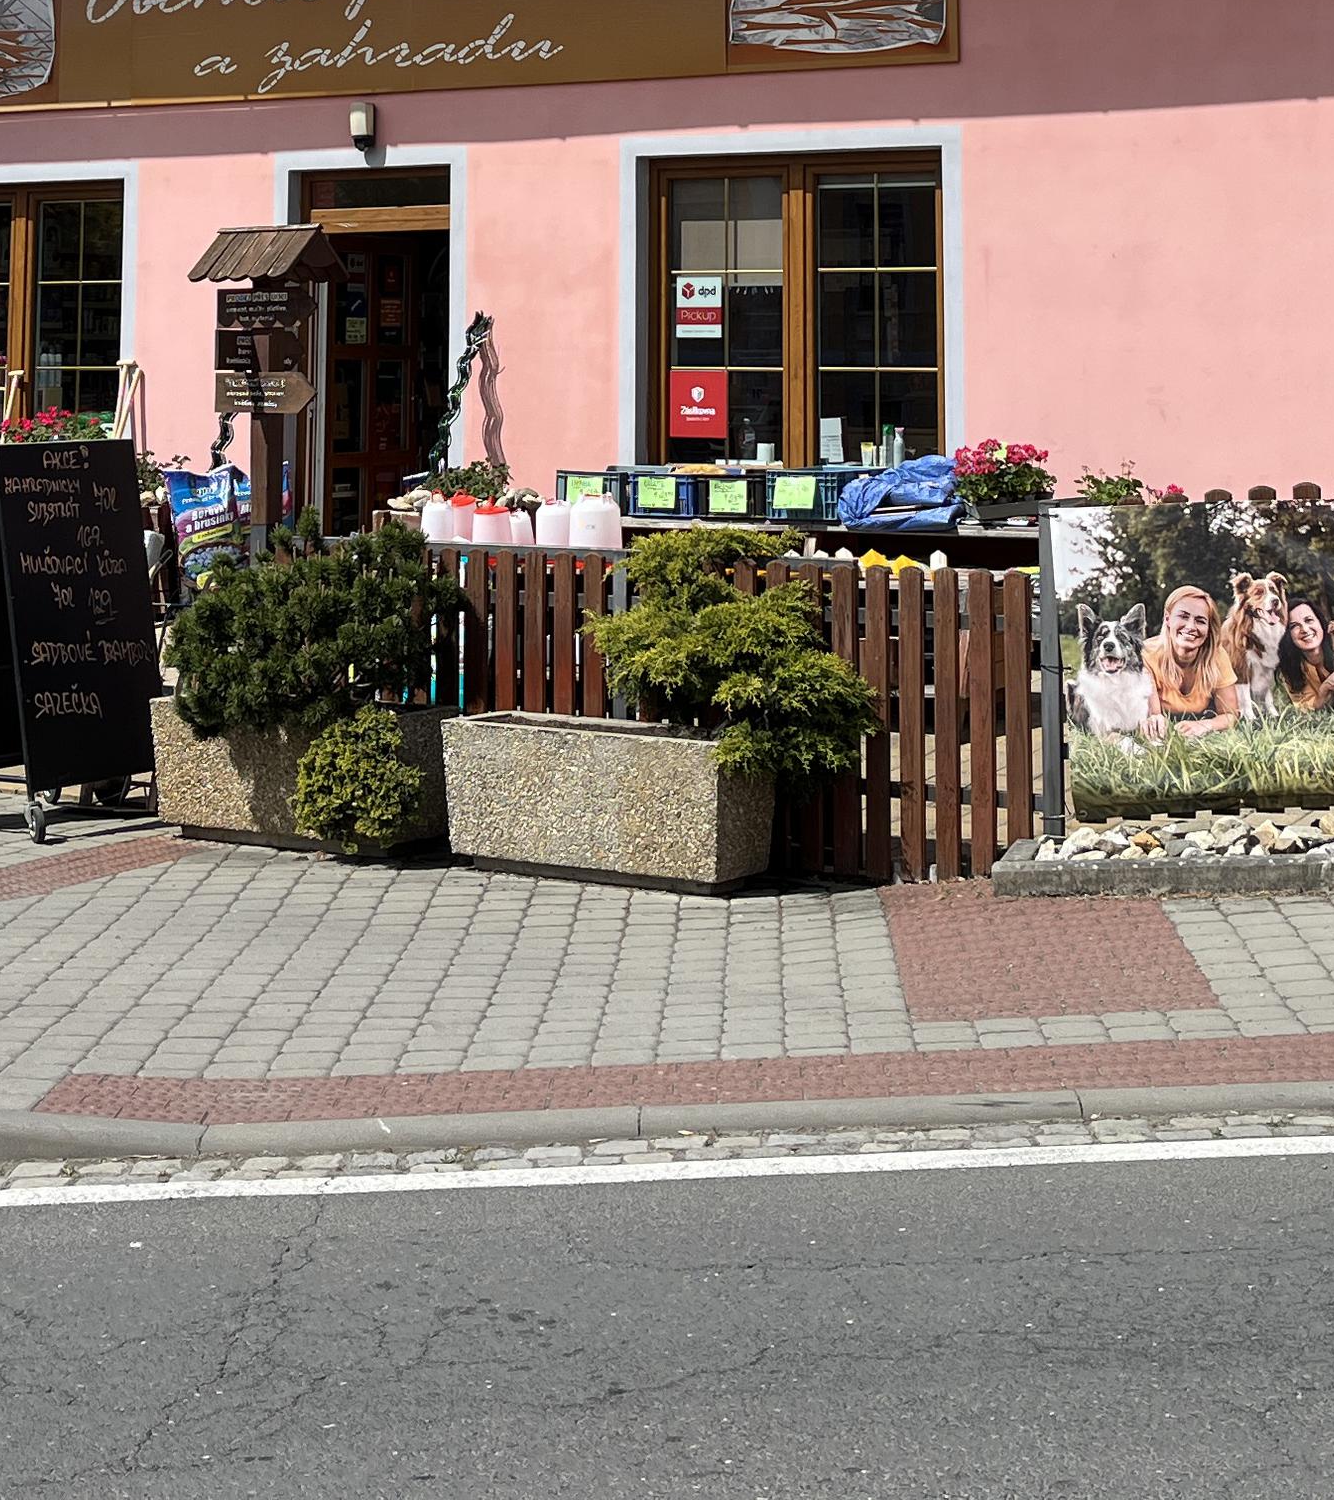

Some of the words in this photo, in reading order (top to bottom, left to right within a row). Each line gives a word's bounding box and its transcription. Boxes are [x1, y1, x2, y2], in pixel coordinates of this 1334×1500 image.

[193, 55, 237, 76] a
[258, 13, 563, 93] zahradu
[698, 285, 717, 298] dpd
[680, 309, 717, 323] Pickup
[34, 683, 103, 719] SAZEČKA
